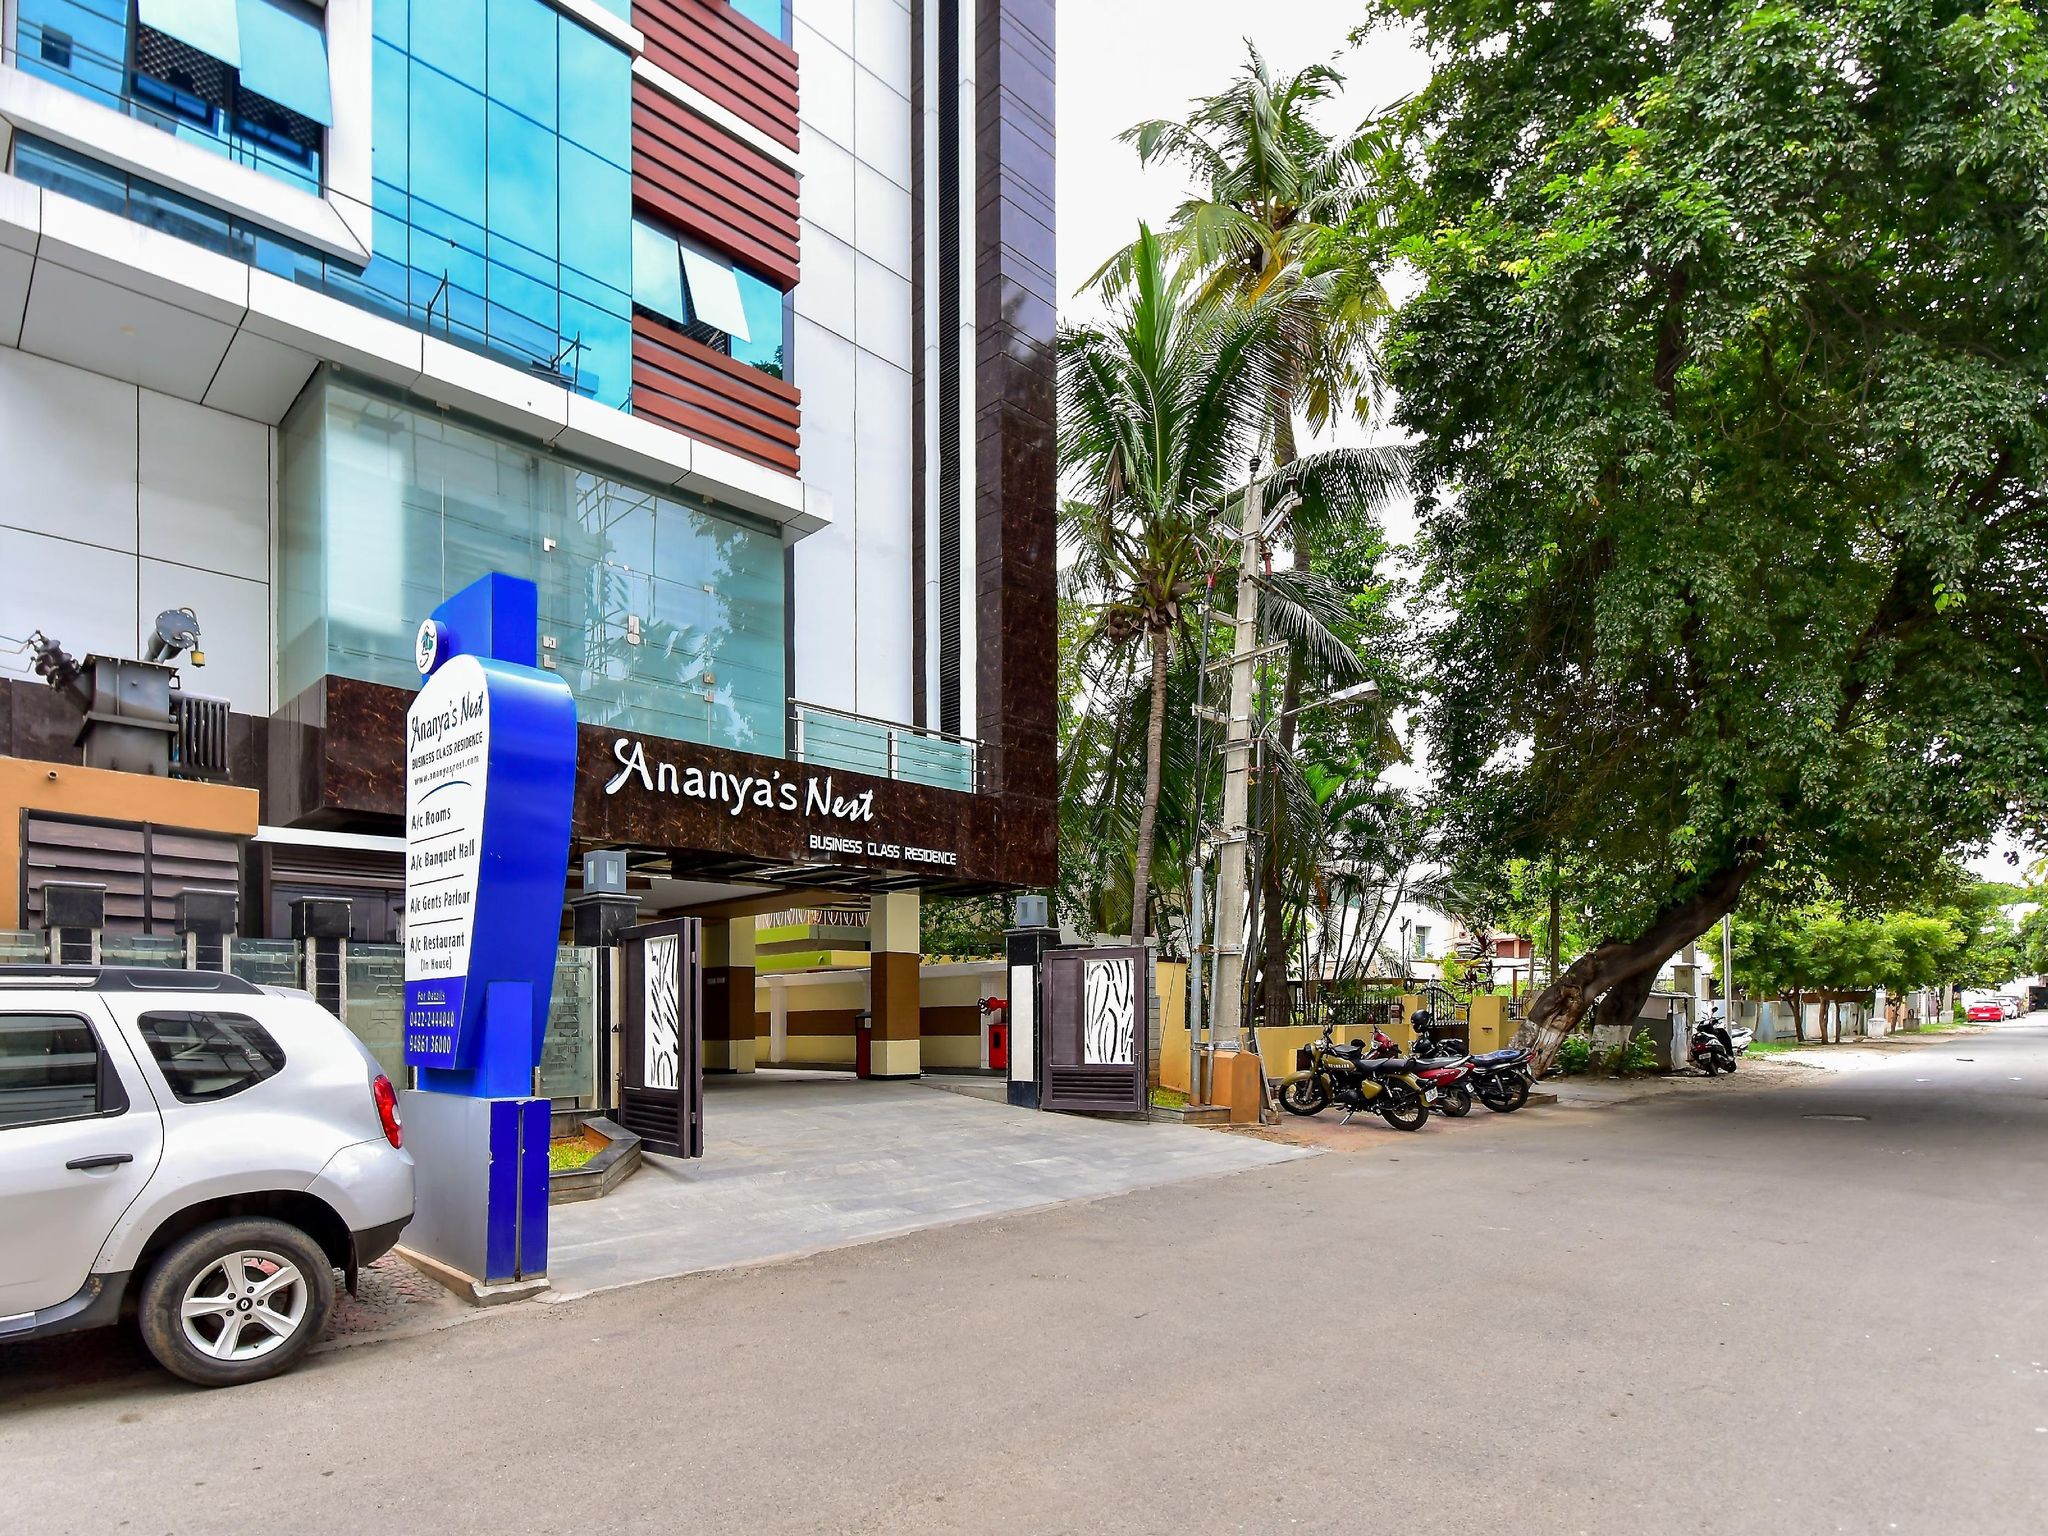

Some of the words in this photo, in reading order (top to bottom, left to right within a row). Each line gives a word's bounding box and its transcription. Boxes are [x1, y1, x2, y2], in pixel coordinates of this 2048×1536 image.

[411, 700, 457, 753] Ananya's
[460, 691, 483, 726] Nest
[412, 751, 435, 770] BUSINESS
[436, 743, 453, 762] CLASS
[454, 731, 483, 753] RESIDENCE
[604, 737, 798, 816] Ananya's
[804, 775, 874, 822] Nest
[411, 814, 424, 831] A/c
[425, 807, 451, 826] Rooms
[411, 854, 423, 871] A/c
[425, 846, 456, 868] Banquet
[459, 838, 475, 859] Hall
[809, 835, 863, 854] BUSINESS
[867, 843, 900, 860] CLASS
[904, 846, 957, 866] RESIDENCE
[423, 894, 442, 911] Gents
[444, 888, 470, 907] Parlour
[423, 931, 465, 951] Restaurant
